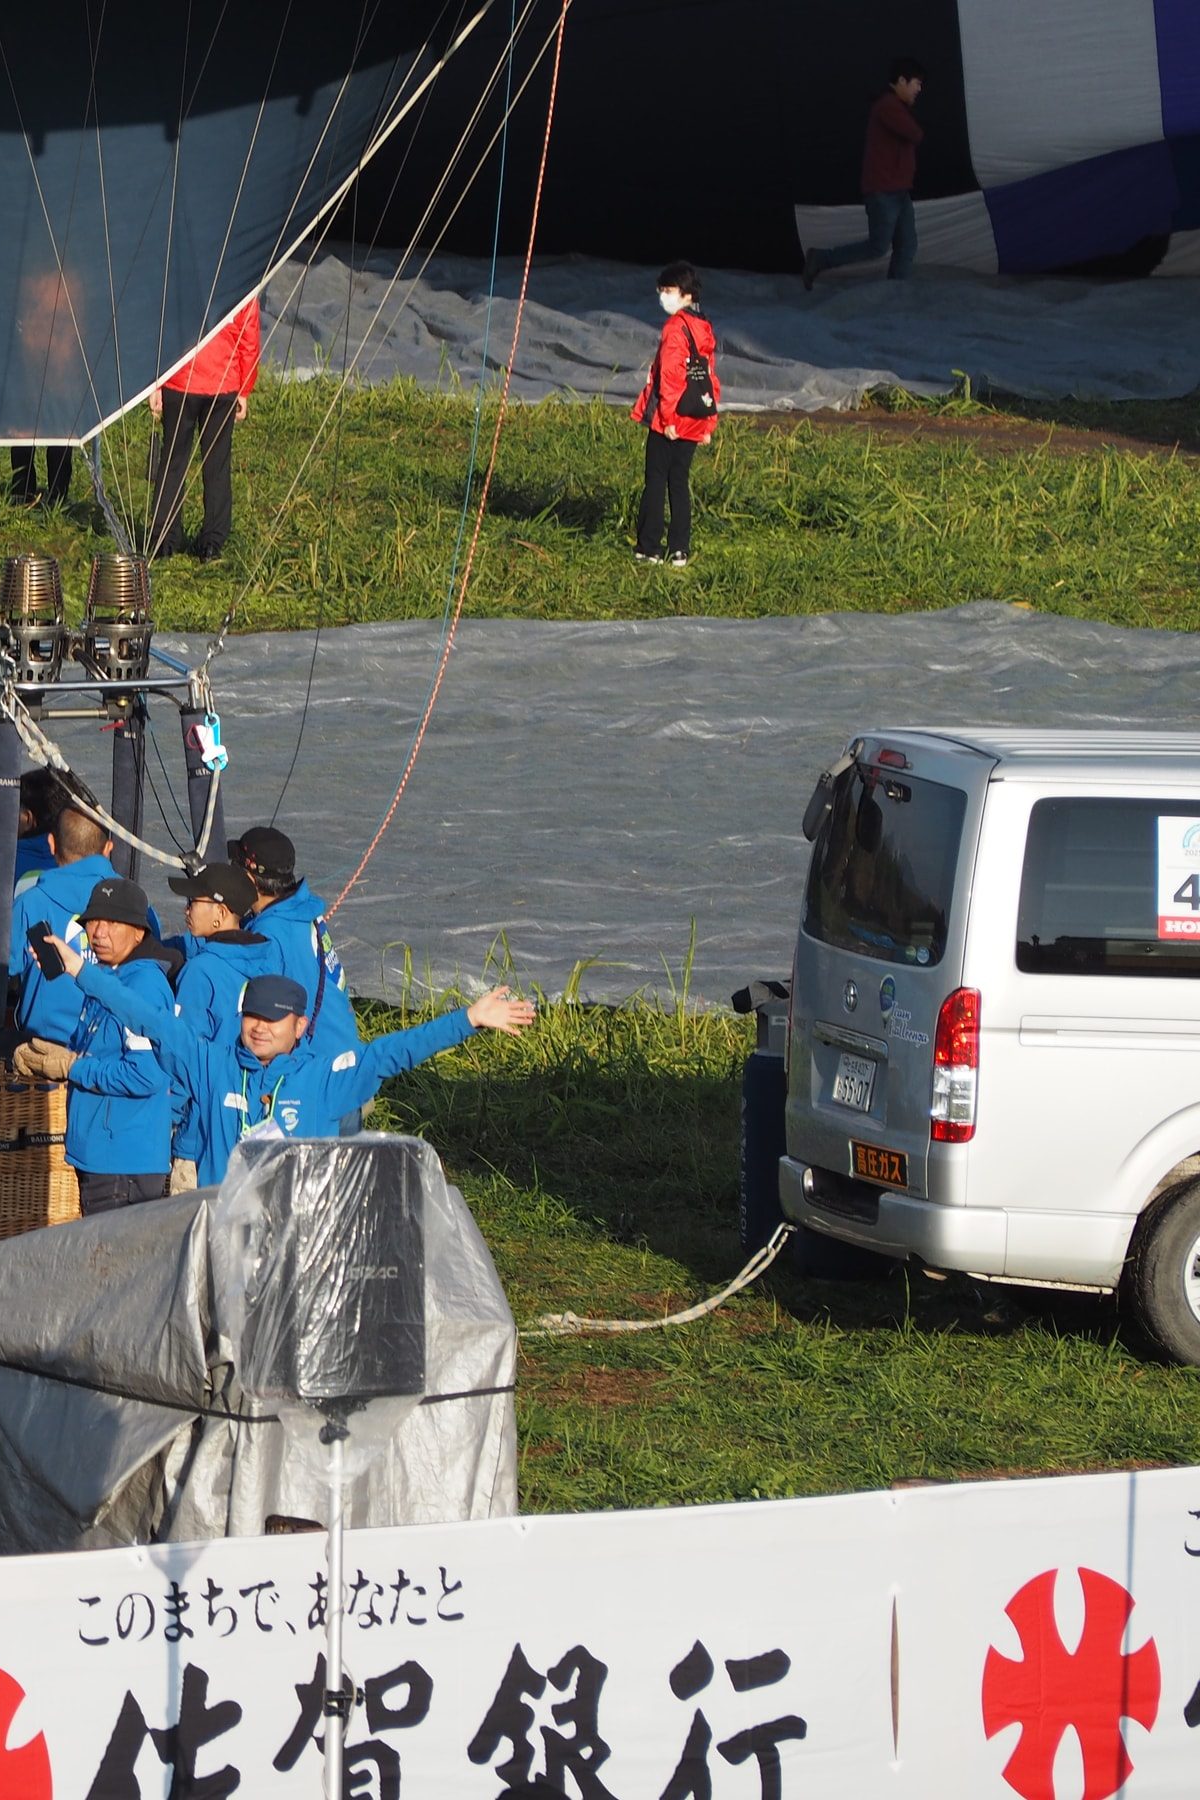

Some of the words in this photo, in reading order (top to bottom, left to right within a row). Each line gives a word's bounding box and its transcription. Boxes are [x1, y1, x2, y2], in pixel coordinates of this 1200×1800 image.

[1165, 920, 1200, 933] HO
[857, 1145, 902, 1182] 高圧ガス
[78, 1566, 465, 1646] このまちで、あなたと
